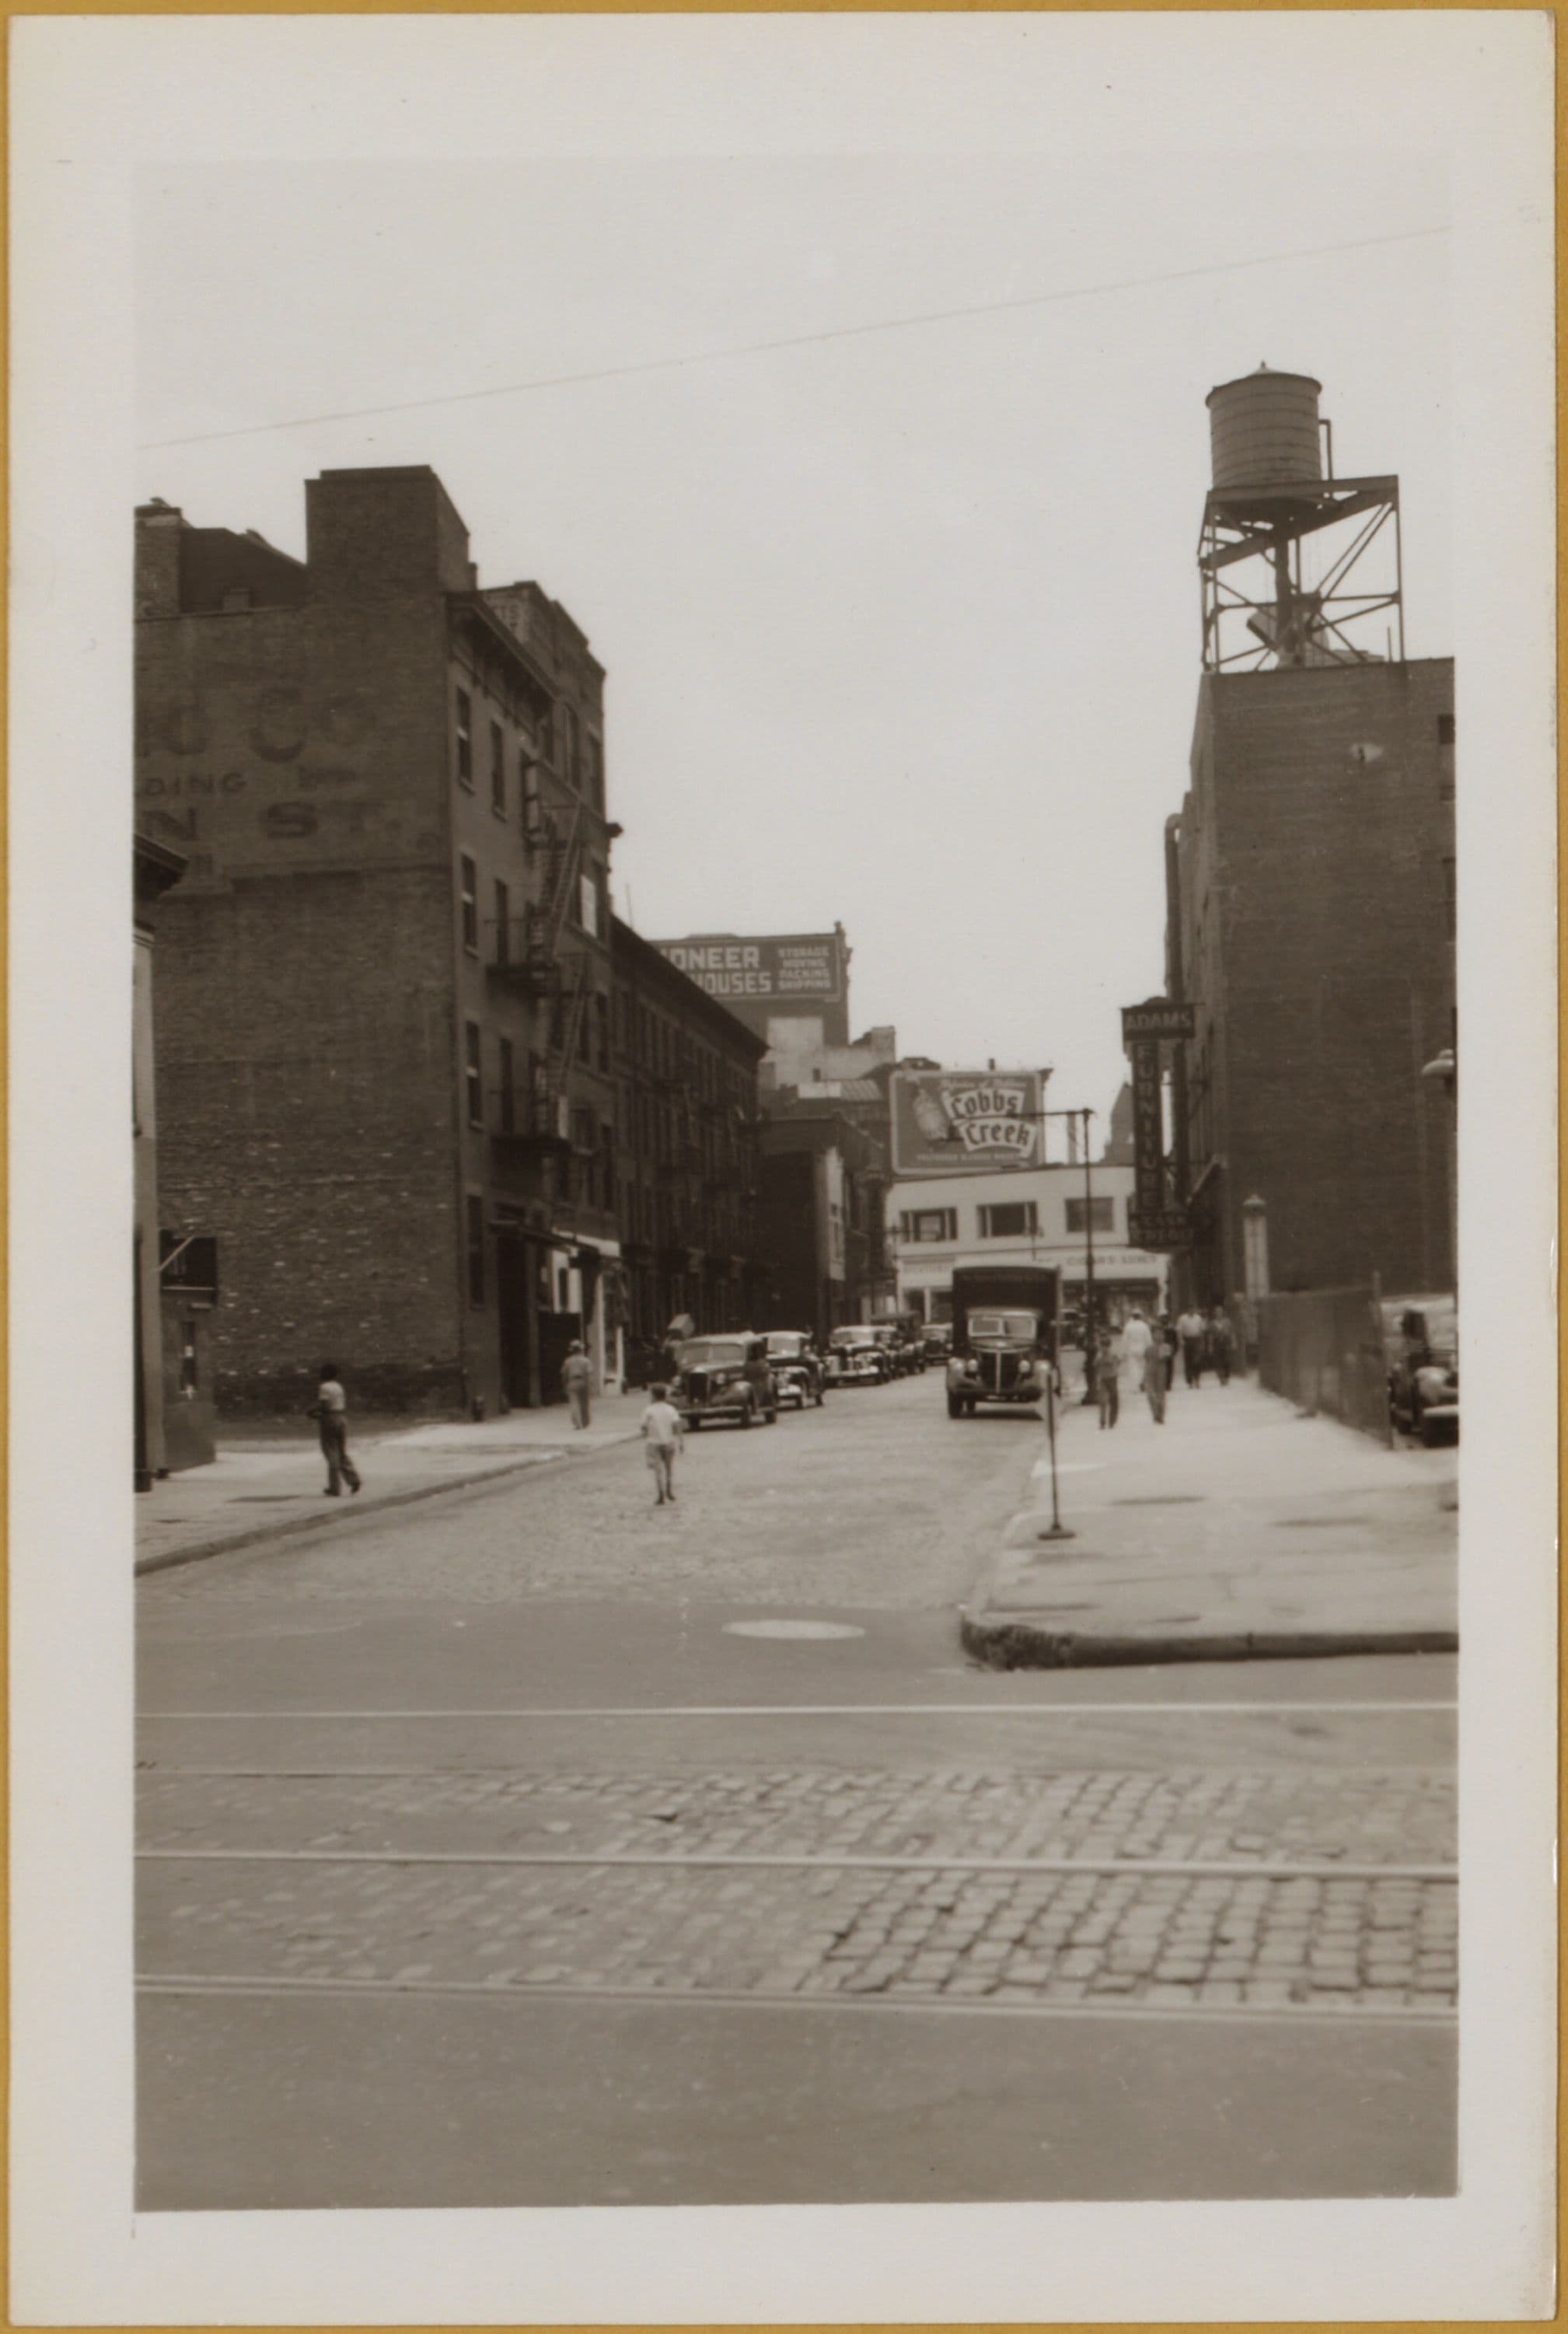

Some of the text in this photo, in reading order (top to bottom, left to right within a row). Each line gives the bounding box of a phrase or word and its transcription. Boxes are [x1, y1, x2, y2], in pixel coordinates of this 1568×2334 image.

[778, 946, 829, 958] STORAGE
[1126, 1012, 1192, 1028] ADAMS
[950, 1090, 1018, 1118] Cobbs
[966, 1122, 1030, 1146] Creek
[1067, 1256, 1115, 1267] CIGRS
